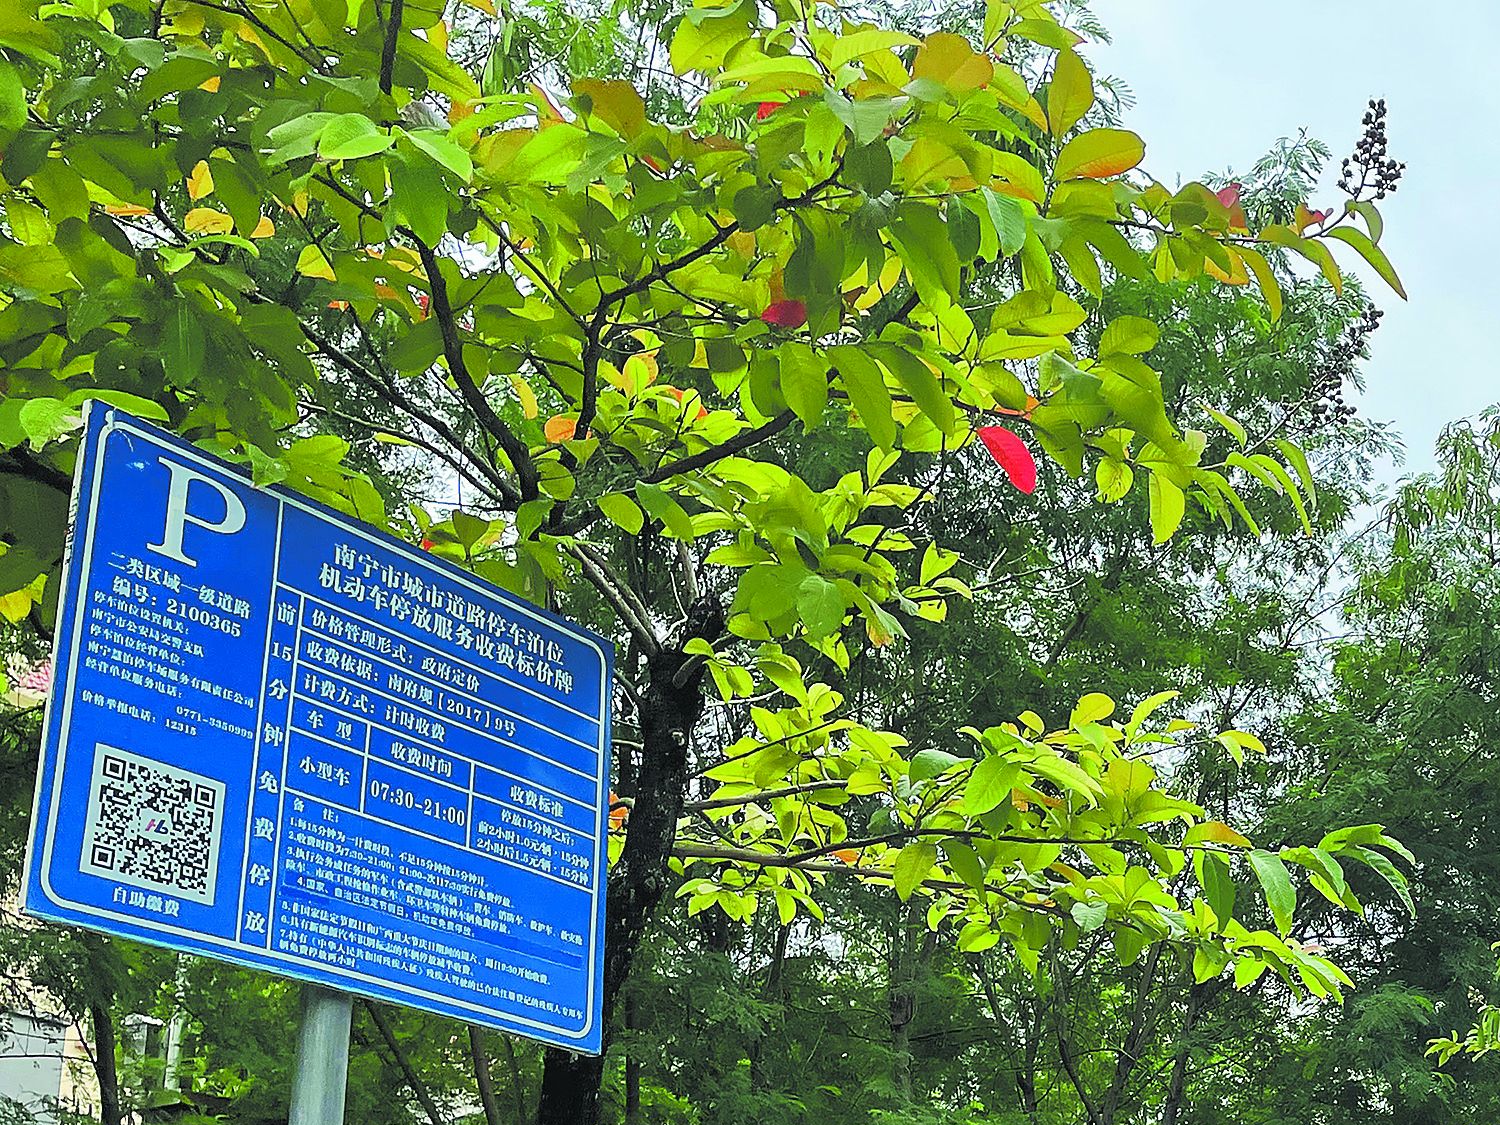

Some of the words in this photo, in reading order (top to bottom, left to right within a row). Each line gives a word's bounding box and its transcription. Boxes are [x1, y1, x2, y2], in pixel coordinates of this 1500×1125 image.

[146, 456, 247, 568] P
[107, 552, 250, 620] 二类区域一级道路
[334, 543, 564, 666] 南宁市城市道路停车泊位
[318, 562, 573, 695] 机动车停放服务收费标价牌
[299, 755, 351, 787] 小型车
[390, 741, 452, 778] 收费时间
[370, 779, 465, 827] 07:30-21:00
[509, 784, 564, 818] 收费标准
[112, 886, 180, 918] 自助缴费
